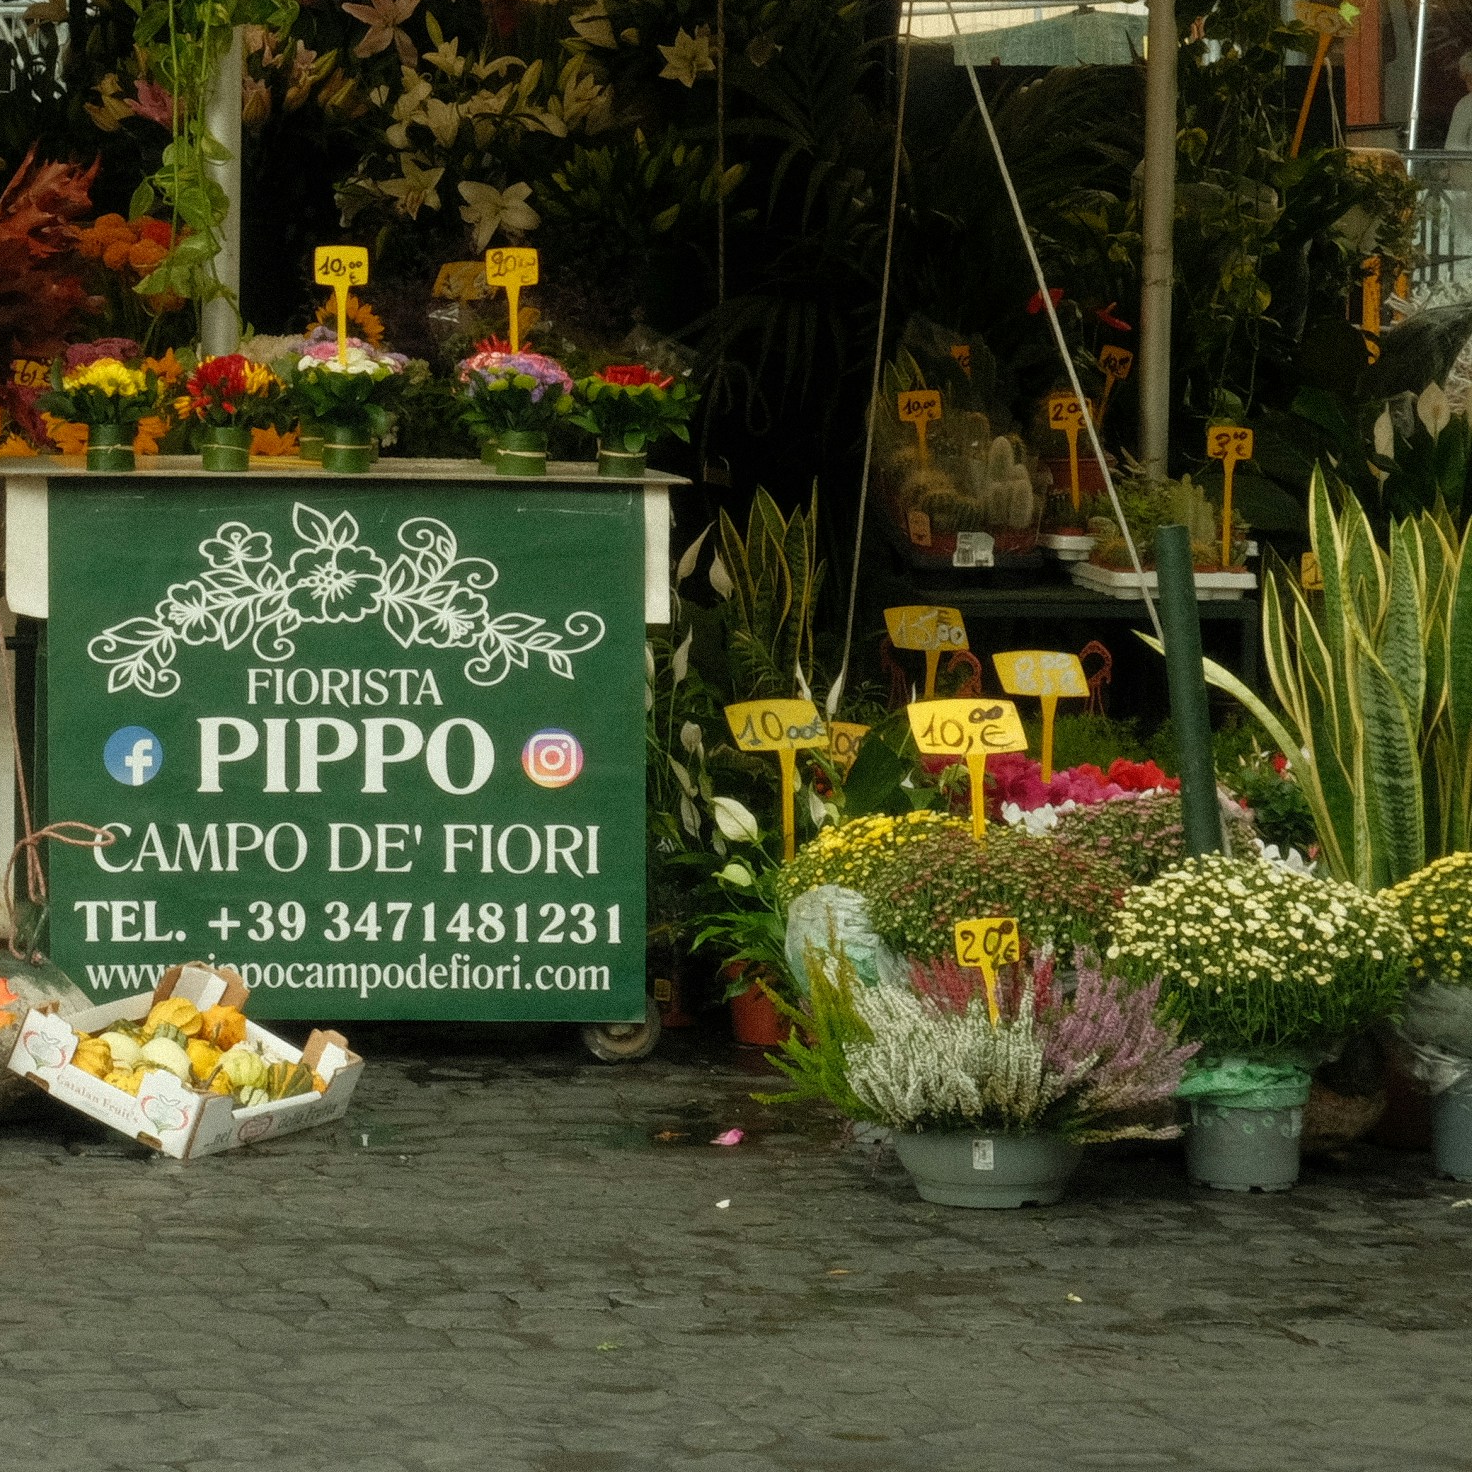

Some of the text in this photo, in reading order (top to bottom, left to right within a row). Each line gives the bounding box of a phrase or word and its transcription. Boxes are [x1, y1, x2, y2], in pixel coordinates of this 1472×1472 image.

[247, 668, 444, 708] FIORISTA
[197, 716, 496, 795] PIPPO
[92, 823, 601, 878] CAMPO DE' FIORI
[73, 900, 622, 945] TEL. +39 3471481231
